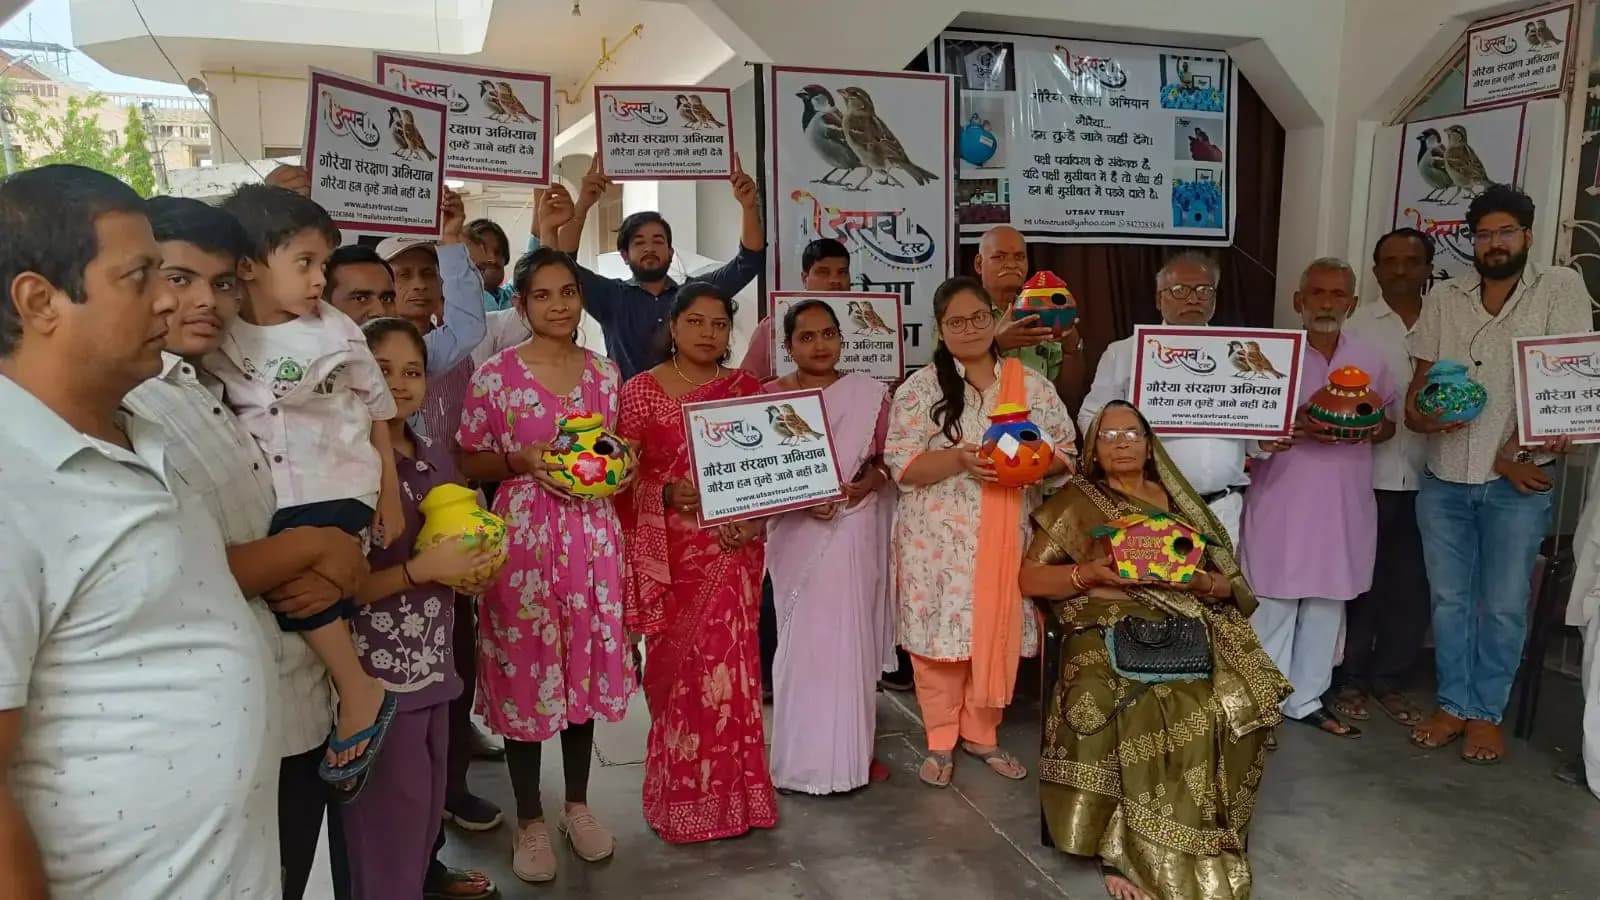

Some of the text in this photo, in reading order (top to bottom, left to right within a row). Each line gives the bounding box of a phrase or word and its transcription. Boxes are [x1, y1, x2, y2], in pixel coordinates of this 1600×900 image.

[1109, 96, 1150, 110] अभियान
[485, 125, 537, 141] अभियान
[607, 132, 724, 144] गौरैया संरक्षण अभियान
[473, 141, 493, 151] जाने
[610, 147, 635, 157] गौरैया
[638, 148, 650, 157] हम
[320, 150, 433, 182] गौरैया संरक्षण अभियान
[1034, 153, 1050, 165] पक्षी
[1055, 153, 1091, 166] पर्यावरण
[1094, 155, 1104, 166] के
[1022, 167, 1039, 179] यदि
[1042, 168, 1060, 181] पक्षी
[1064, 168, 1097, 183] मुसीबत
[1121, 171, 1131, 183] तो
[1153, 173, 1163, 185] ही
[321, 176, 346, 192] गौरैया
[348, 182, 362, 193] हम
[381, 184, 398, 196] जाने
[1028, 185, 1041, 196] हम
[1057, 184, 1091, 199] मुसीबत
[1128, 186, 1145, 199] वाले
[344, 201, 408, 212] www.utsavtrust.com
[852, 339, 893, 350] अभियान
[1146, 380, 1282, 396] गौरैया संरक्षण अभियान
[1535, 388, 1576, 401] गौरैया
[1147, 397, 1174, 407] गौरैया
[1177, 398, 1192, 407] हम
[1217, 398, 1236, 408] जाने
[1540, 405, 1571, 415] गौरैया
[1575, 404, 1592, 414] हम
[703, 447, 826, 478] गौरैया संरक्षण अभियान
[707, 479, 734, 493] गौरैया
[737, 478, 751, 489] हम
[775, 469, 793, 482] जाने
[736, 484, 809, 502] www.utsavtrust.com
